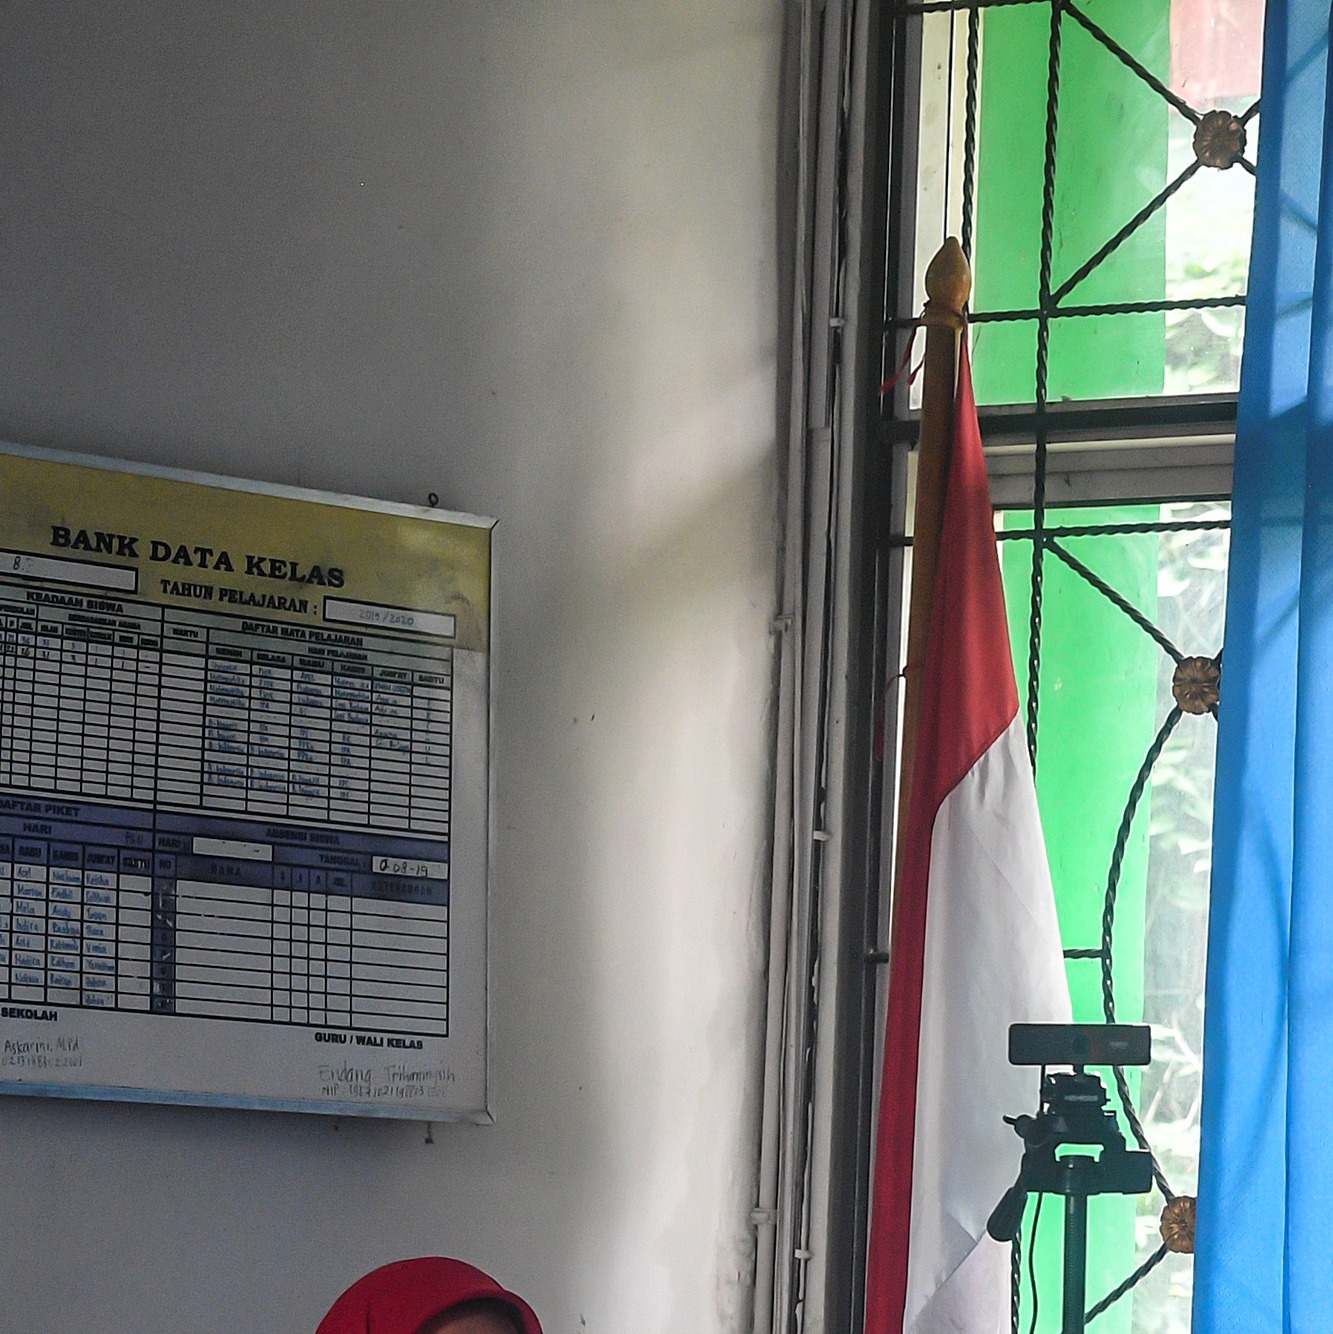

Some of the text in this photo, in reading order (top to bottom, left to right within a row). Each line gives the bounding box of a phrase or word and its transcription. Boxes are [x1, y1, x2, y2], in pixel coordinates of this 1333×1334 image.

[50, 525, 346, 588] BANK DATA KELAS
[160, 579, 214, 602] TAHUN
[217, 586, 310, 614] PELAJARAN
[241, 621, 279, 635] DAFTAR
[308, 630, 363, 647] PELAJARAN
[45, 804, 81, 817] PIKET
[22, 822, 52, 835] HARI
[1, 1007, 58, 1021] SEKOLAH
[315, 1032, 347, 1043] GURU
[355, 1035, 384, 1047] WALI
[387, 1038, 424, 1050] KELAS
